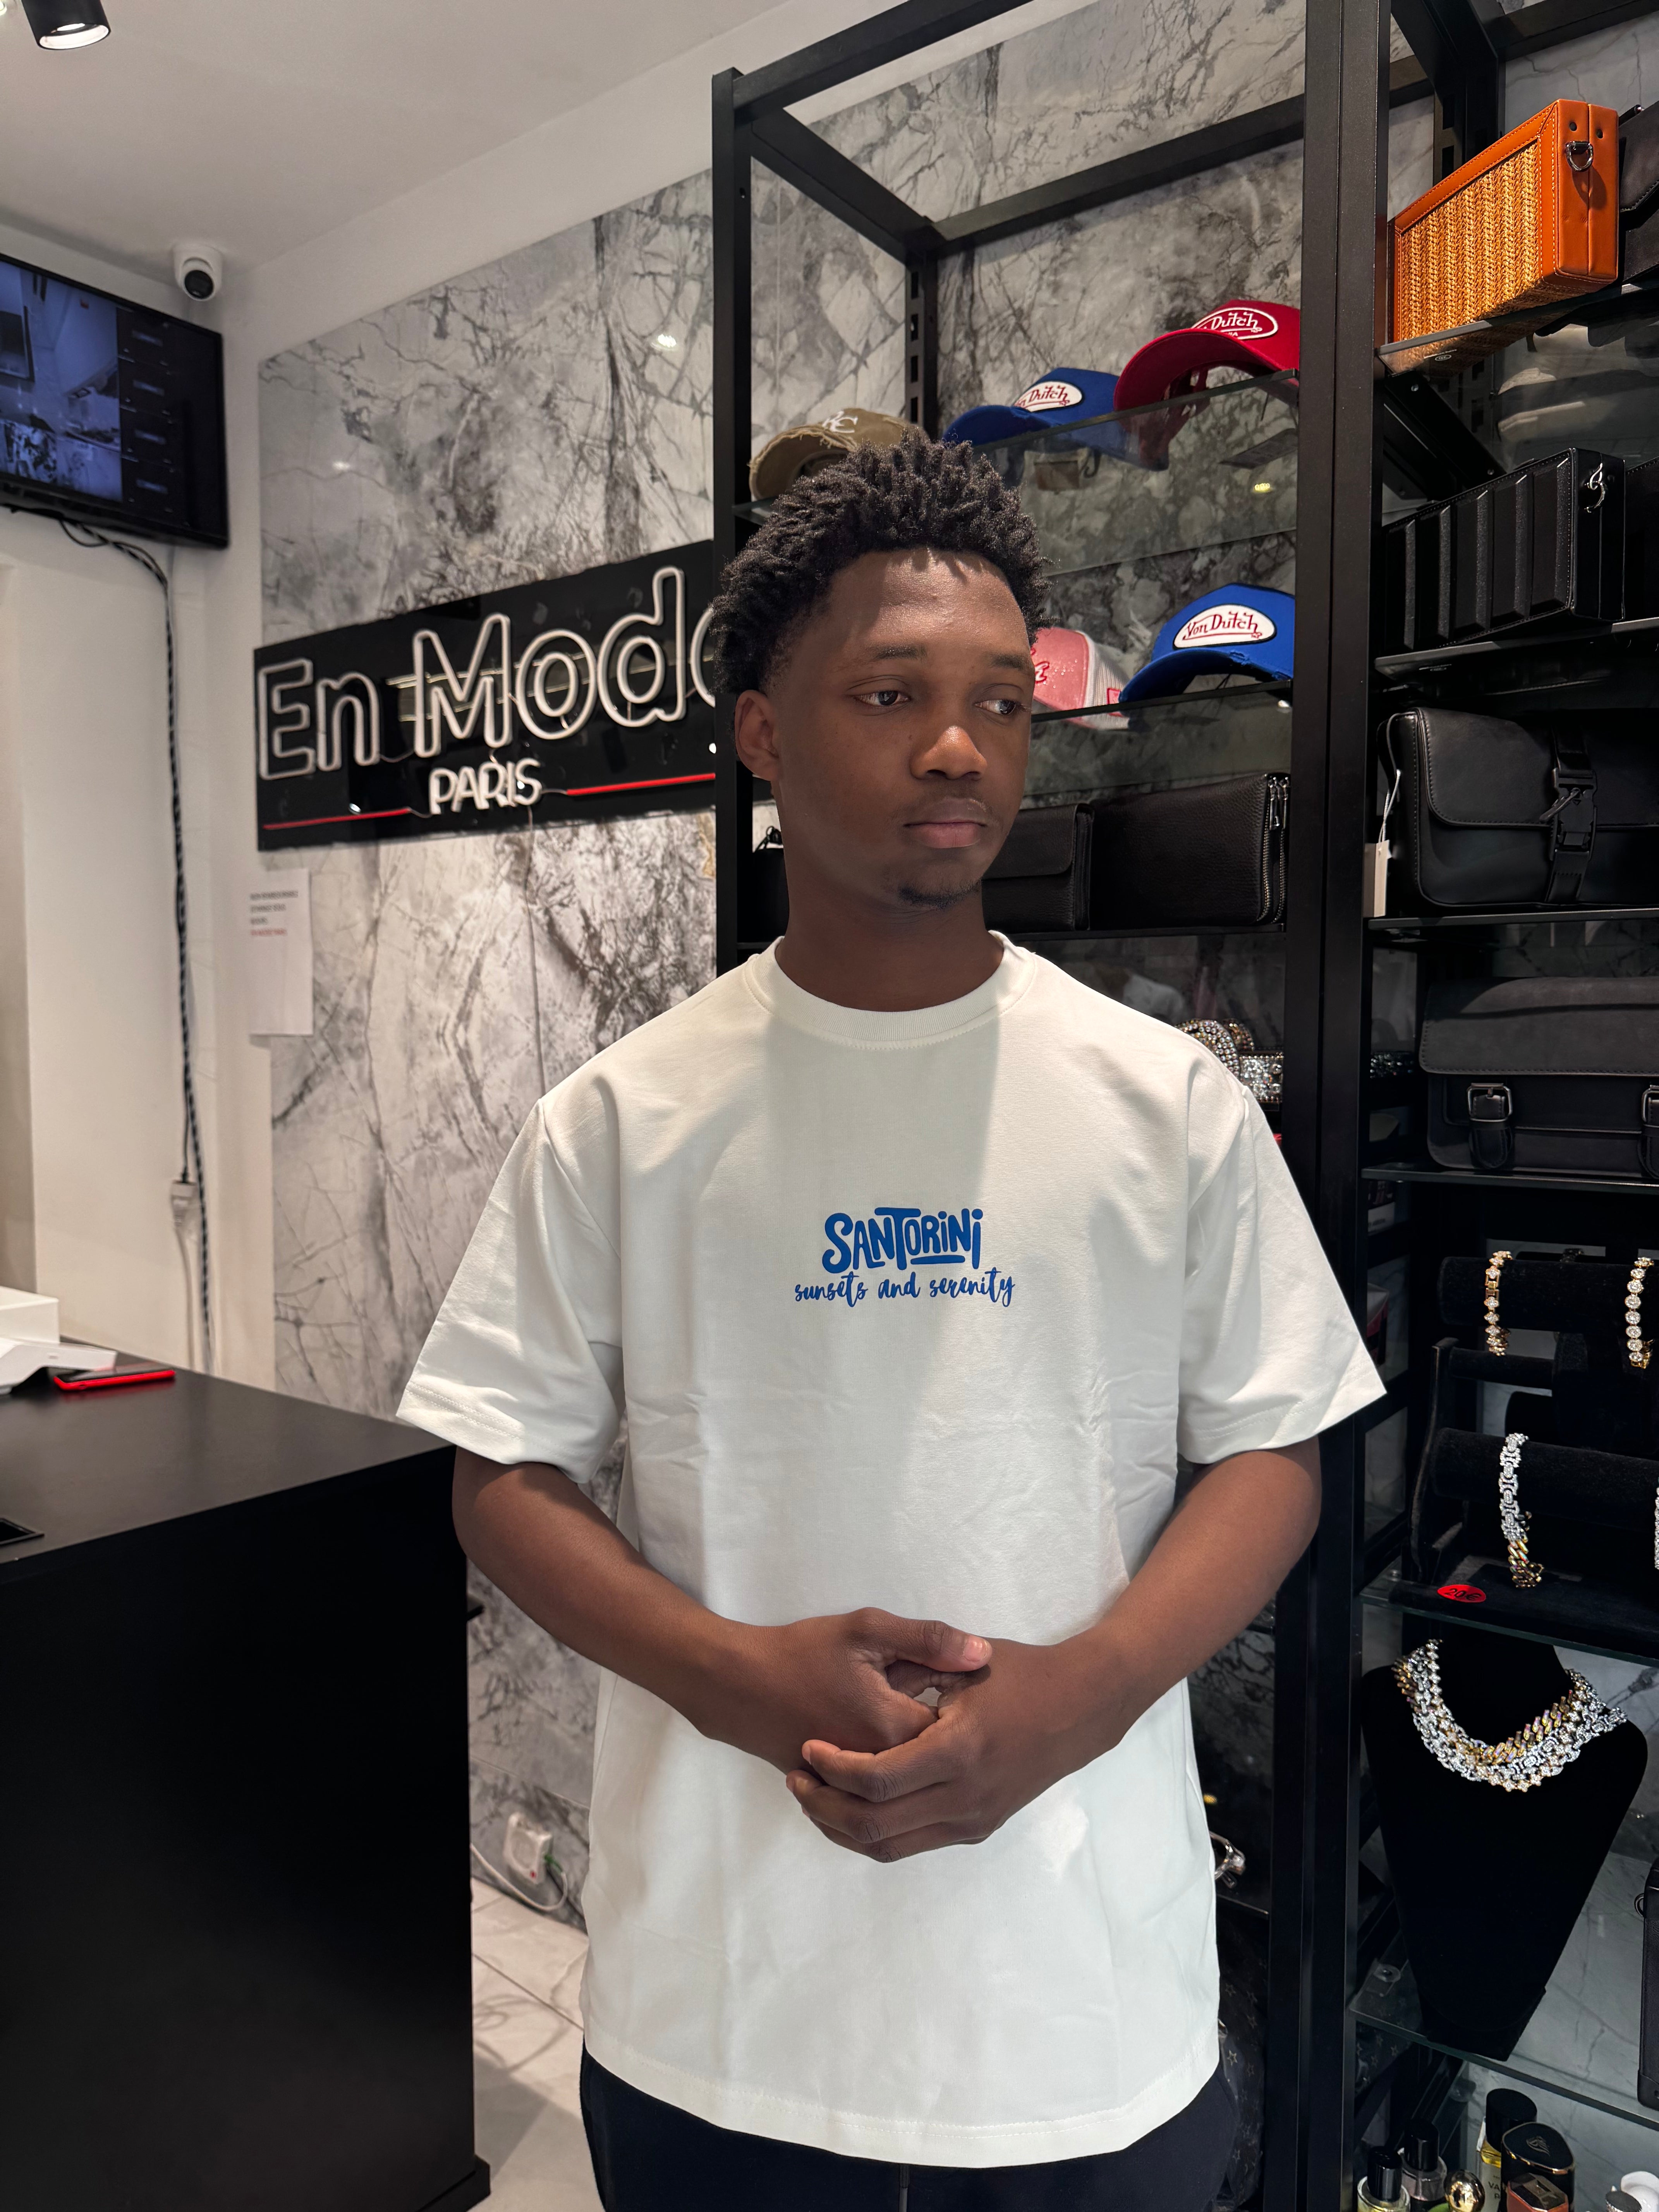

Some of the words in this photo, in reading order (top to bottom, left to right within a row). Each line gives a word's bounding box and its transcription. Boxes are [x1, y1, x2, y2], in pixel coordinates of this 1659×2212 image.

[1028, 385, 1069, 404] Dutch
[1183, 622, 1208, 639] Von
[1210, 611, 1260, 635] Dutch
[258, 658, 380, 780] En
[429, 757, 542, 815] PARIS
[795, 1271, 868, 1307] sunsets
[878, 1272, 921, 1298] and
[929, 1267, 1015, 1307] serenity
[1444, 1588, 1482, 1601] 20€
